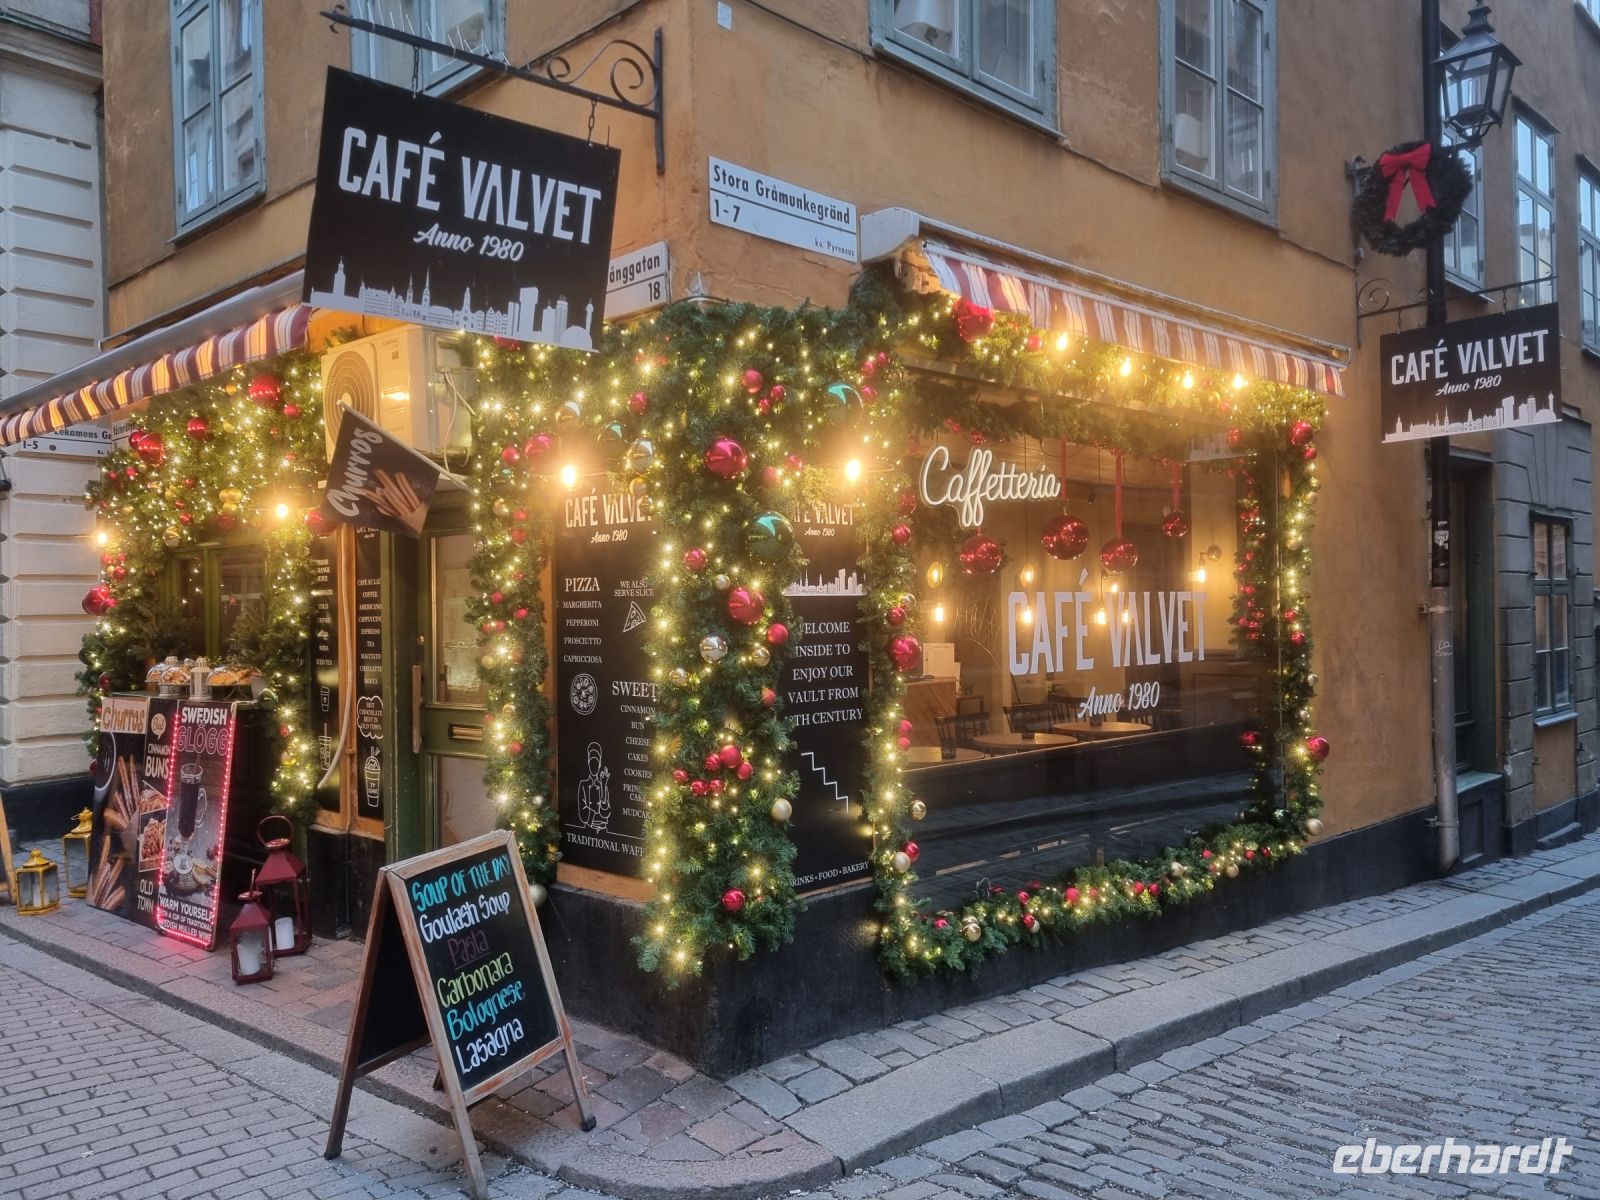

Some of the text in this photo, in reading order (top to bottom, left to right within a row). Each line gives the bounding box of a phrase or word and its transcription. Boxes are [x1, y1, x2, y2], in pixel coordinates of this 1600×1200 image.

[338, 126, 601, 245] CAFÉ VALVET
[713, 164, 850, 225] Stora Gråmunkegränd
[714, 199, 740, 223] 1-7
[413, 223, 525, 263] Anno 1980
[648, 281, 661, 301] 18
[1391, 329, 1549, 385] CAFÉ VALVET
[1436, 375, 1502, 396] Anno 1980
[327, 428, 383, 517] Churros
[922, 446, 1061, 528] Caffetteria
[565, 488, 598, 528] CAFÉ
[590, 529, 628, 544] Anno 1980
[804, 526, 836, 537] Anno 1980
[565, 577, 600, 592] PIZZA
[614, 589, 634, 597] SERVE
[620, 580, 630, 588] WE
[563, 600, 602, 609] MARGHERITA
[566, 619, 599, 627] PEPPERONI
[1007, 567, 1208, 676] CAFÉ VALVET
[564, 637, 602, 645] PROSCIUTTO
[795, 643, 851, 657] INSIDE TO
[563, 654, 603, 664] CAPRICCIOSA
[792, 665, 853, 683] ENJOY OUR
[788, 687, 859, 703] VAULT FROM
[1077, 681, 1160, 719] Anno 1980
[181, 707, 228, 725] SWEDISH
[631, 721, 645, 730] BUN
[812, 708, 864, 725] CENTURY
[176, 722, 230, 756] GLÖGG
[625, 737, 651, 746] CHEESE
[627, 753, 649, 762] CAKES
[145, 756, 170, 780] BUNS
[624, 768, 653, 779] COOKIES
[566, 832, 620, 853] TRADITIONAL
[790, 861, 870, 887] RINKS FOOD BAKERY
[140, 879, 154, 895] OLD
[412, 876, 448, 912] SOUP
[450, 869, 467, 897] OF
[468, 861, 494, 890] THE
[137, 895, 154, 913] TOWN
[159, 896, 179, 912] WARM
[419, 891, 511, 944] Goulash Soup
[447, 928, 490, 967] Pasta
[437, 951, 514, 1009] Carbonara
[446, 980, 523, 1041] Bolognese
[455, 1018, 525, 1075] Lasagna
